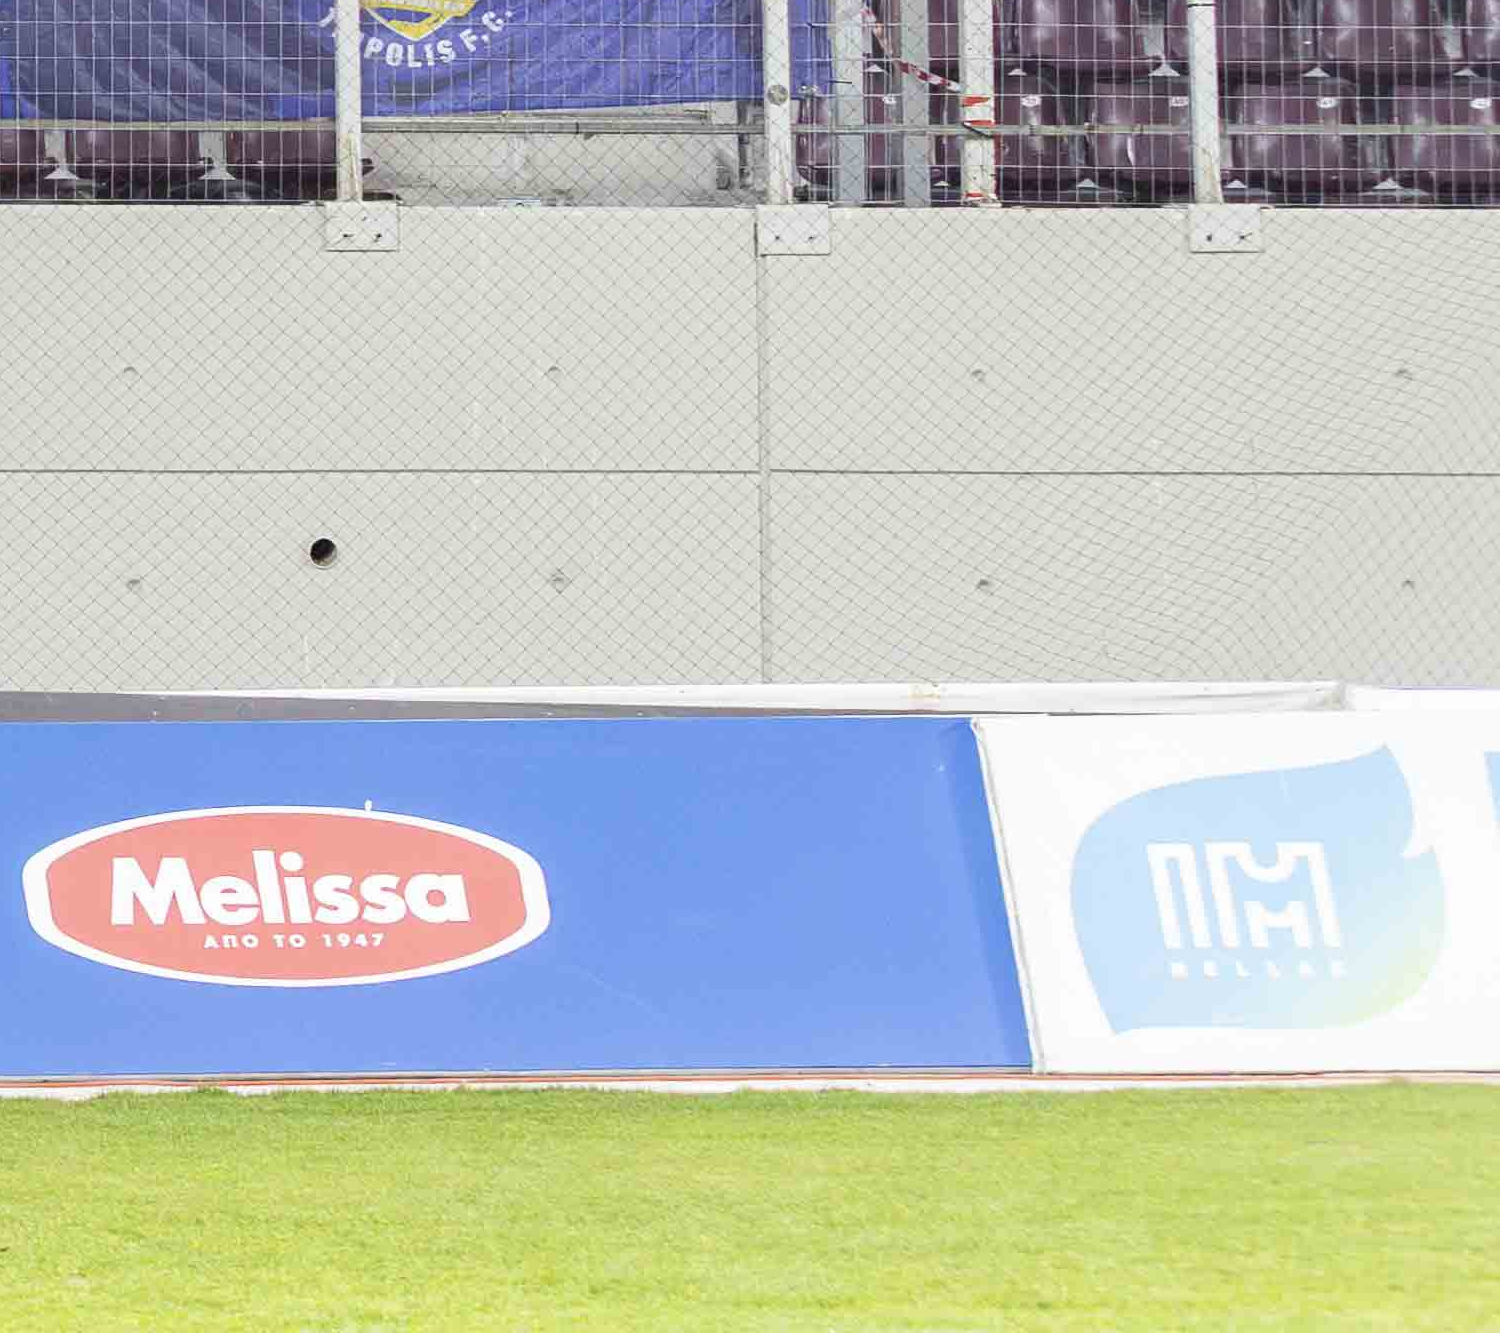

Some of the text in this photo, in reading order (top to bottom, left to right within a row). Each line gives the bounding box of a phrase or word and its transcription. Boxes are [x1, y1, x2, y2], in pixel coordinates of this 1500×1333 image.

[110, 849, 471, 927] Melissa
[203, 933, 385, 950] ΑΠΟ ΤΟ 1947
